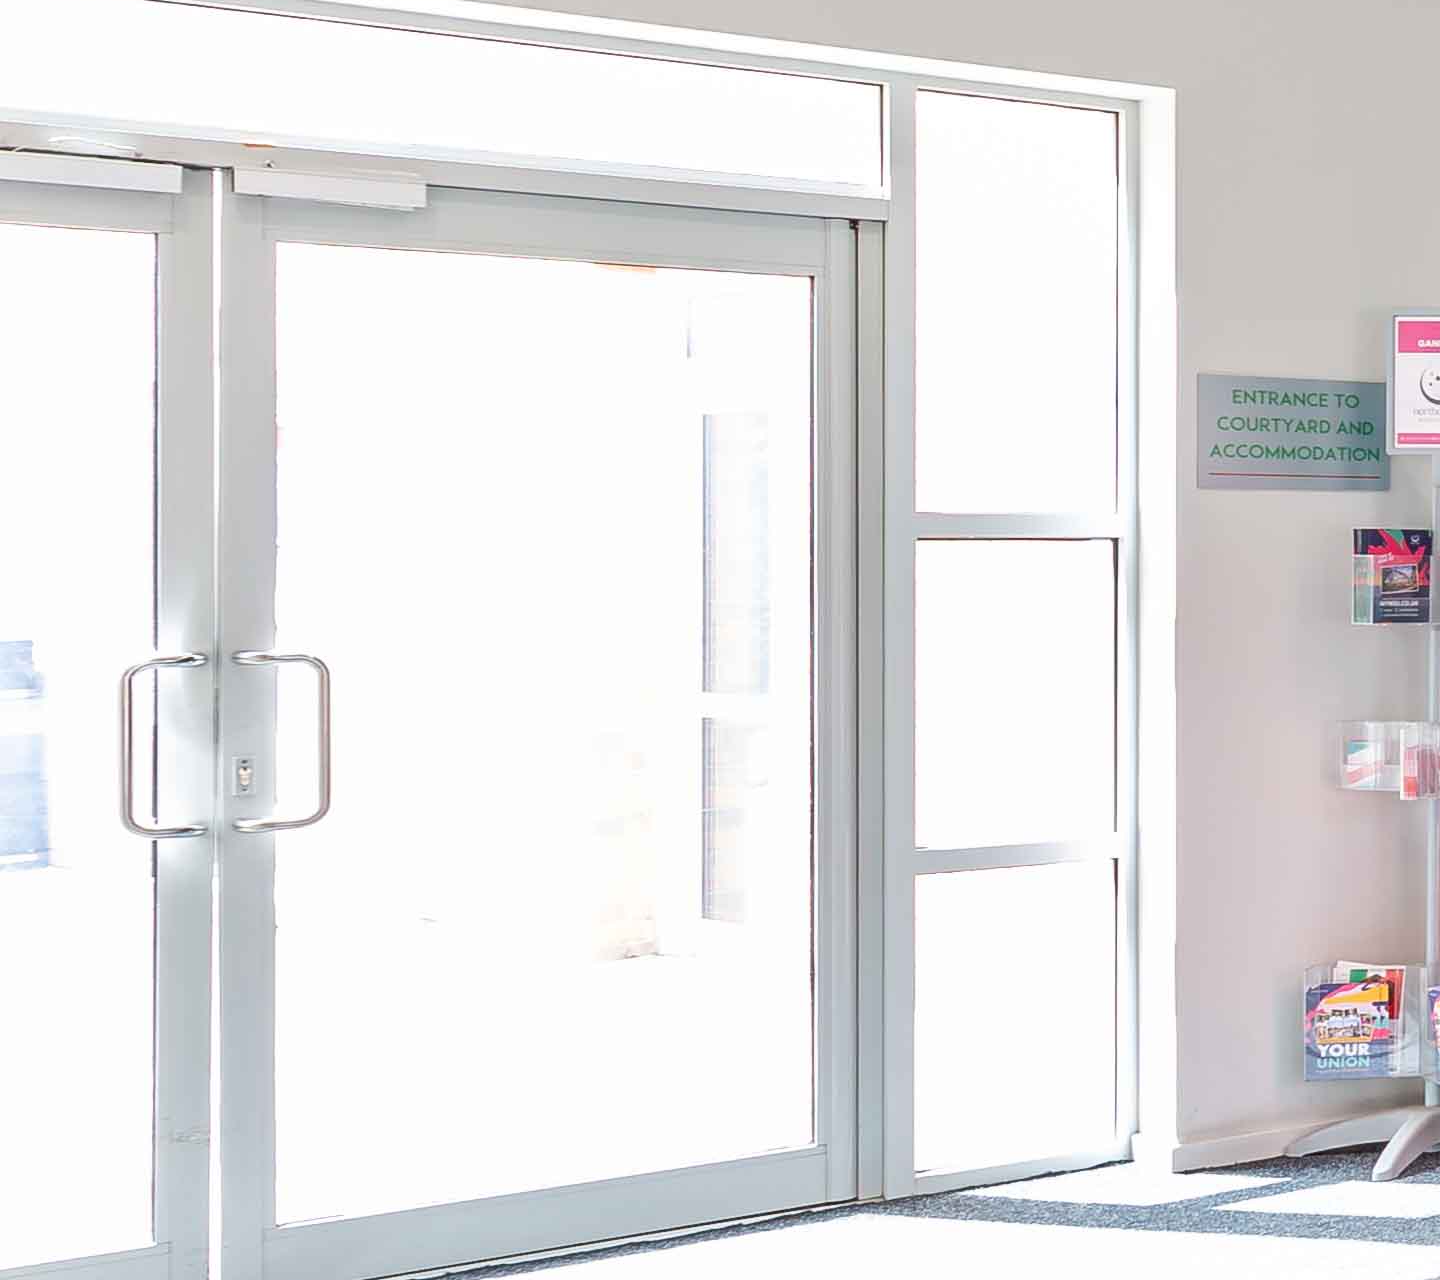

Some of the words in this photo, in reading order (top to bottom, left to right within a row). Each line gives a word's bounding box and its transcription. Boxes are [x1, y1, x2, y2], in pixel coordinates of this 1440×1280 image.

[1232, 389, 1328, 408] ENTRANCE
[1334, 393, 1360, 409] TO
[1217, 416, 1330, 435] COURTYARD
[1336, 420, 1374, 436] AND
[1209, 443, 1380, 462] ACCOMMODATION
[1317, 1043, 1369, 1058] YOUR
[1316, 1056, 1370, 1069] UNION
